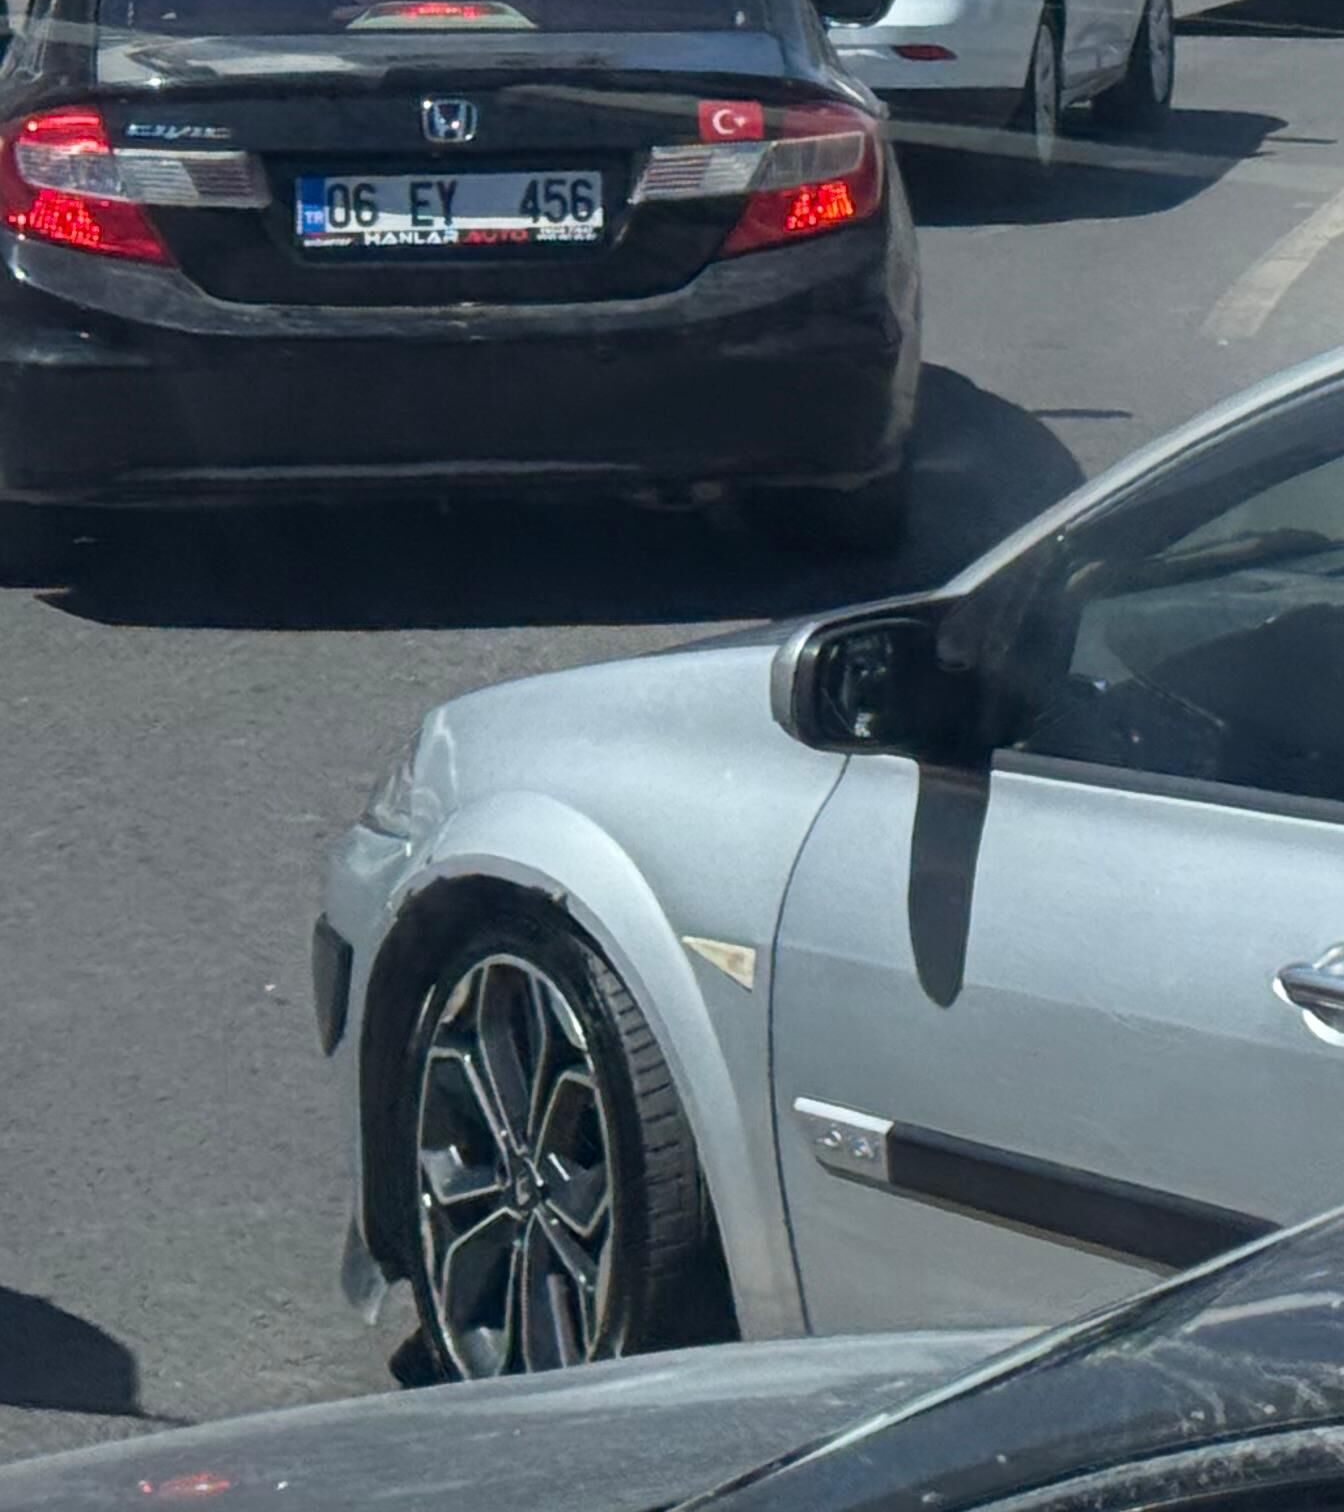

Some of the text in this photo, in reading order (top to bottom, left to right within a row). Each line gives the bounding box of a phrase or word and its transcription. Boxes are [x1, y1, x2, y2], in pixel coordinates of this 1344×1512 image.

[327, 178, 594, 229] 06 EY 456
[304, 209, 324, 225] TR
[363, 230, 458, 246] HANLAR
[462, 227, 528, 245] AUTO
